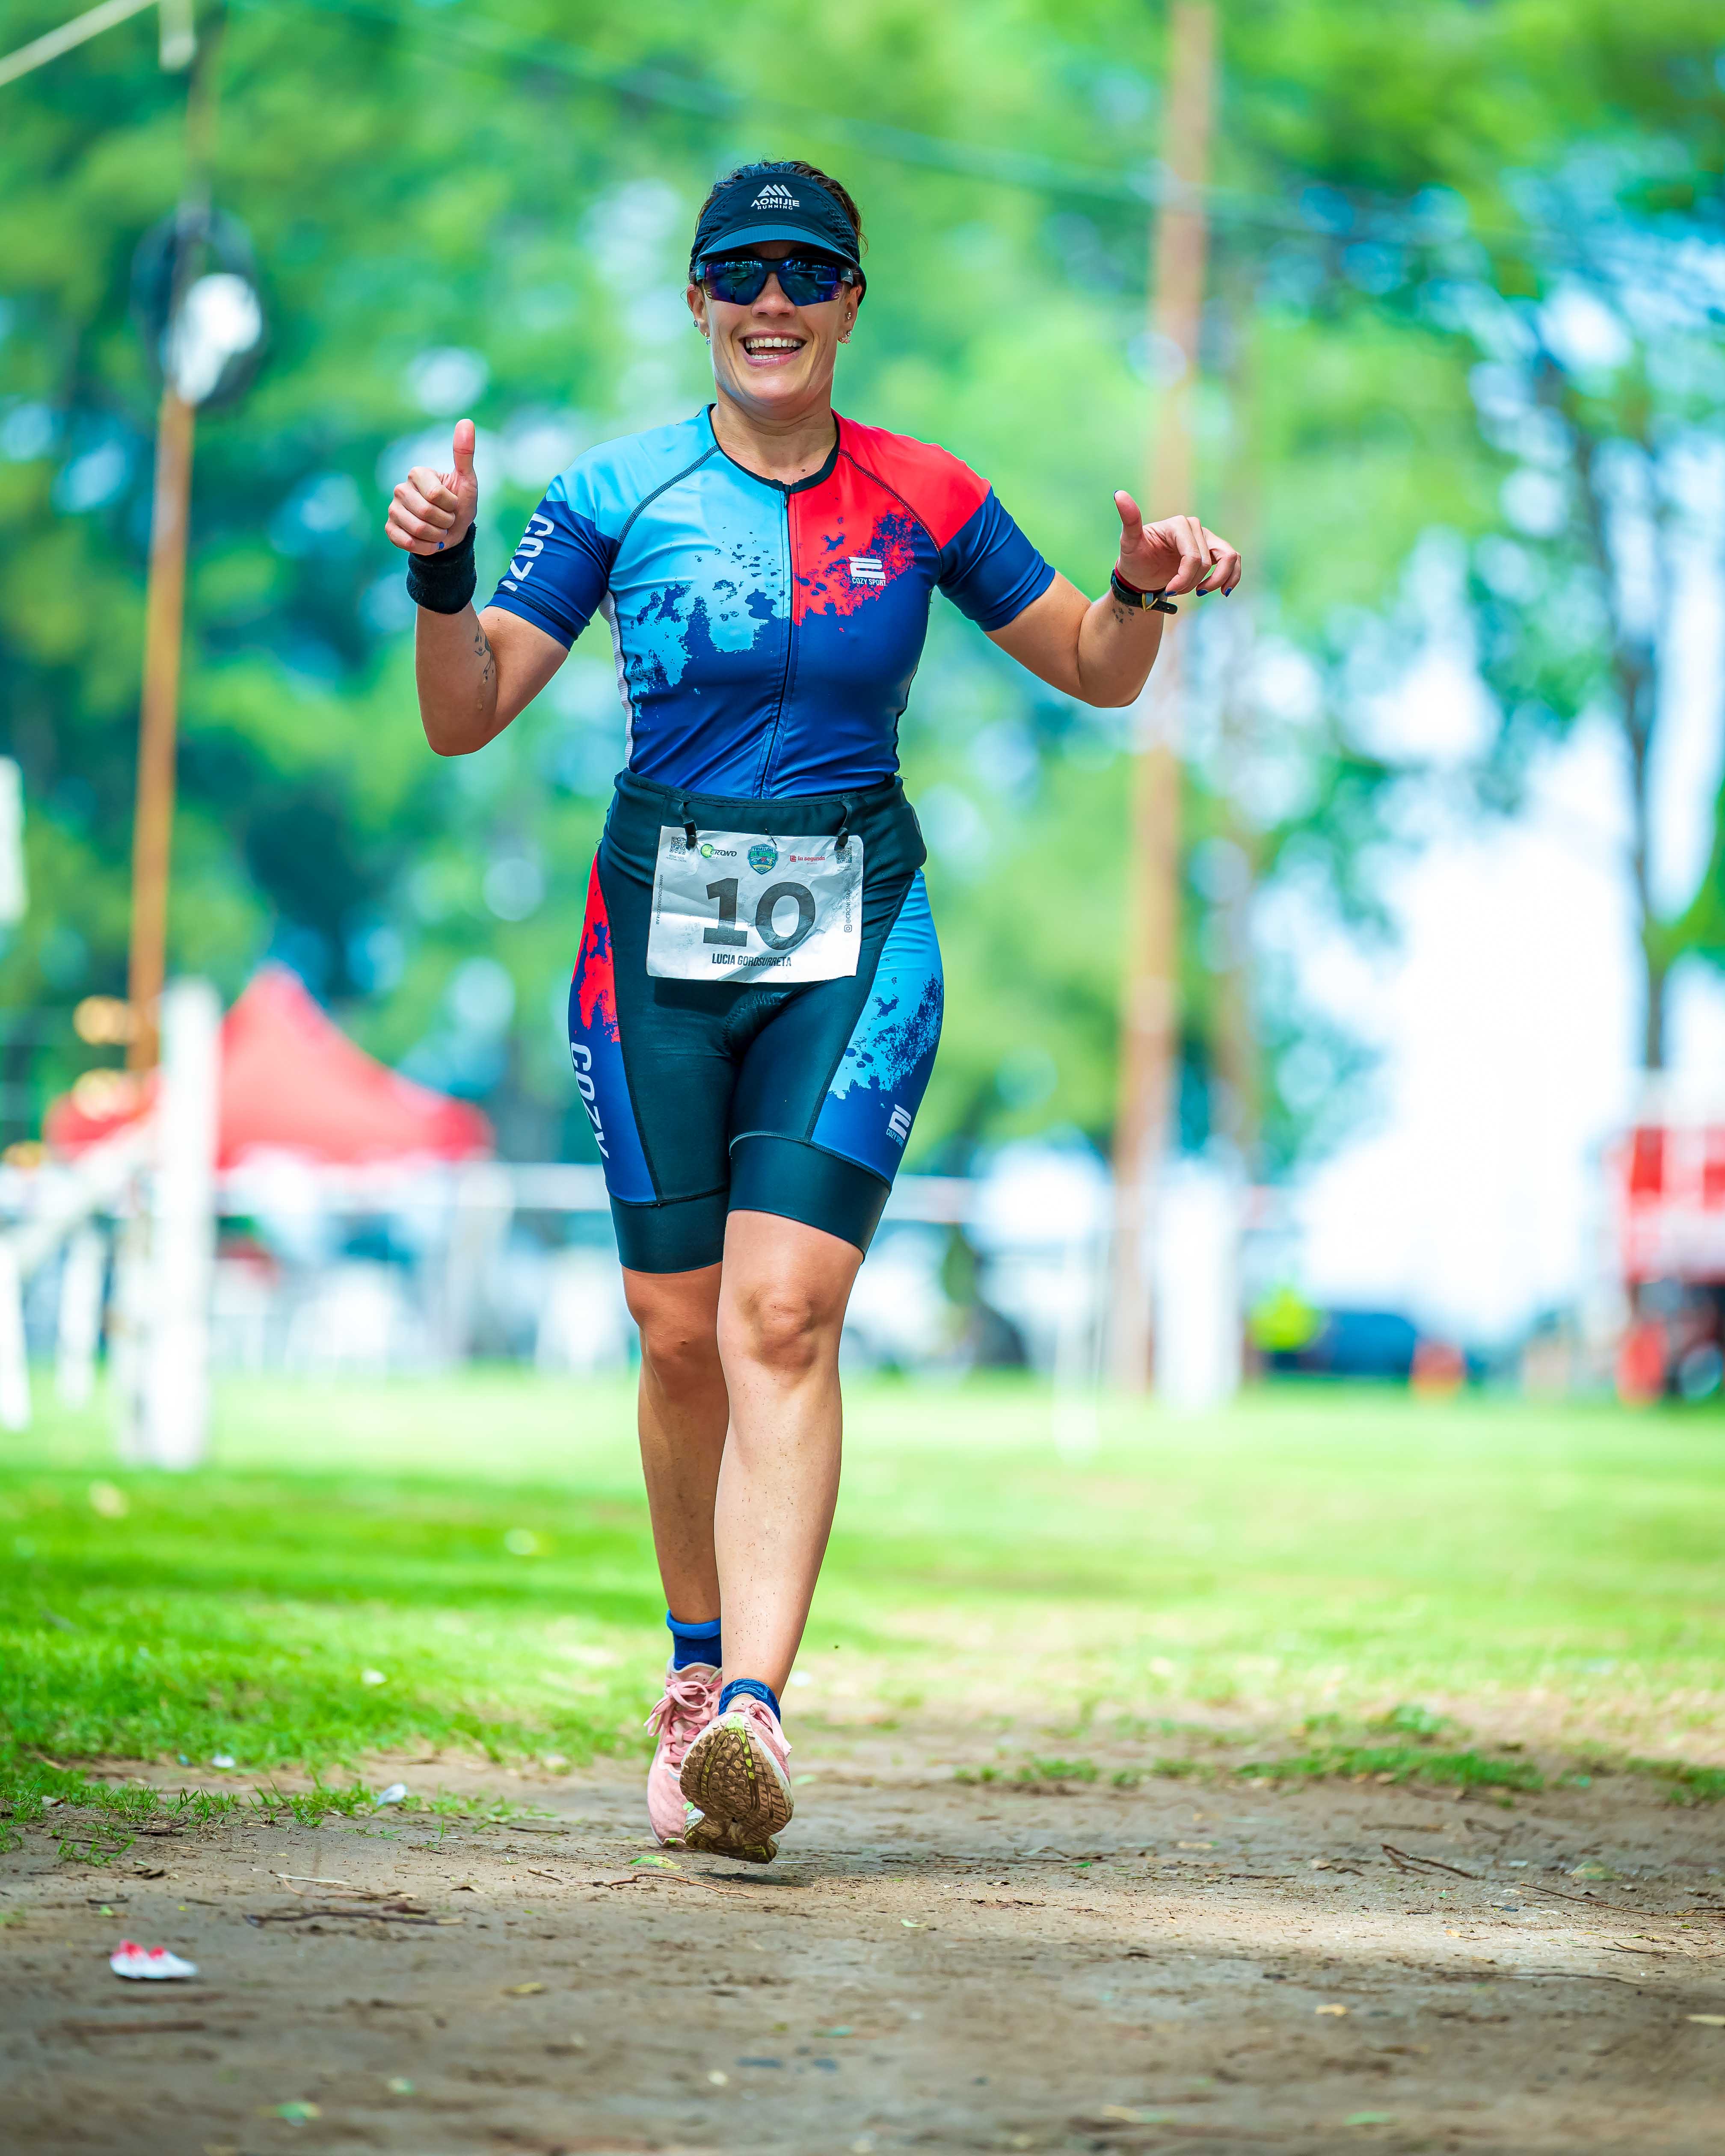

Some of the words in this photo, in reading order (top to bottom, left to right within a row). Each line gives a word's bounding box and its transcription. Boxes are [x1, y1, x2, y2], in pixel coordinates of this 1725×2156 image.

[750, 198, 800, 207] AONIJIE
[710, 849, 737, 857] CRONO
[702, 877, 816, 951] 10
[712, 953, 735, 965] LUCIA
[738, 955, 791, 967] GOROSURRETA
[886, 1128, 897, 1140] COZY
